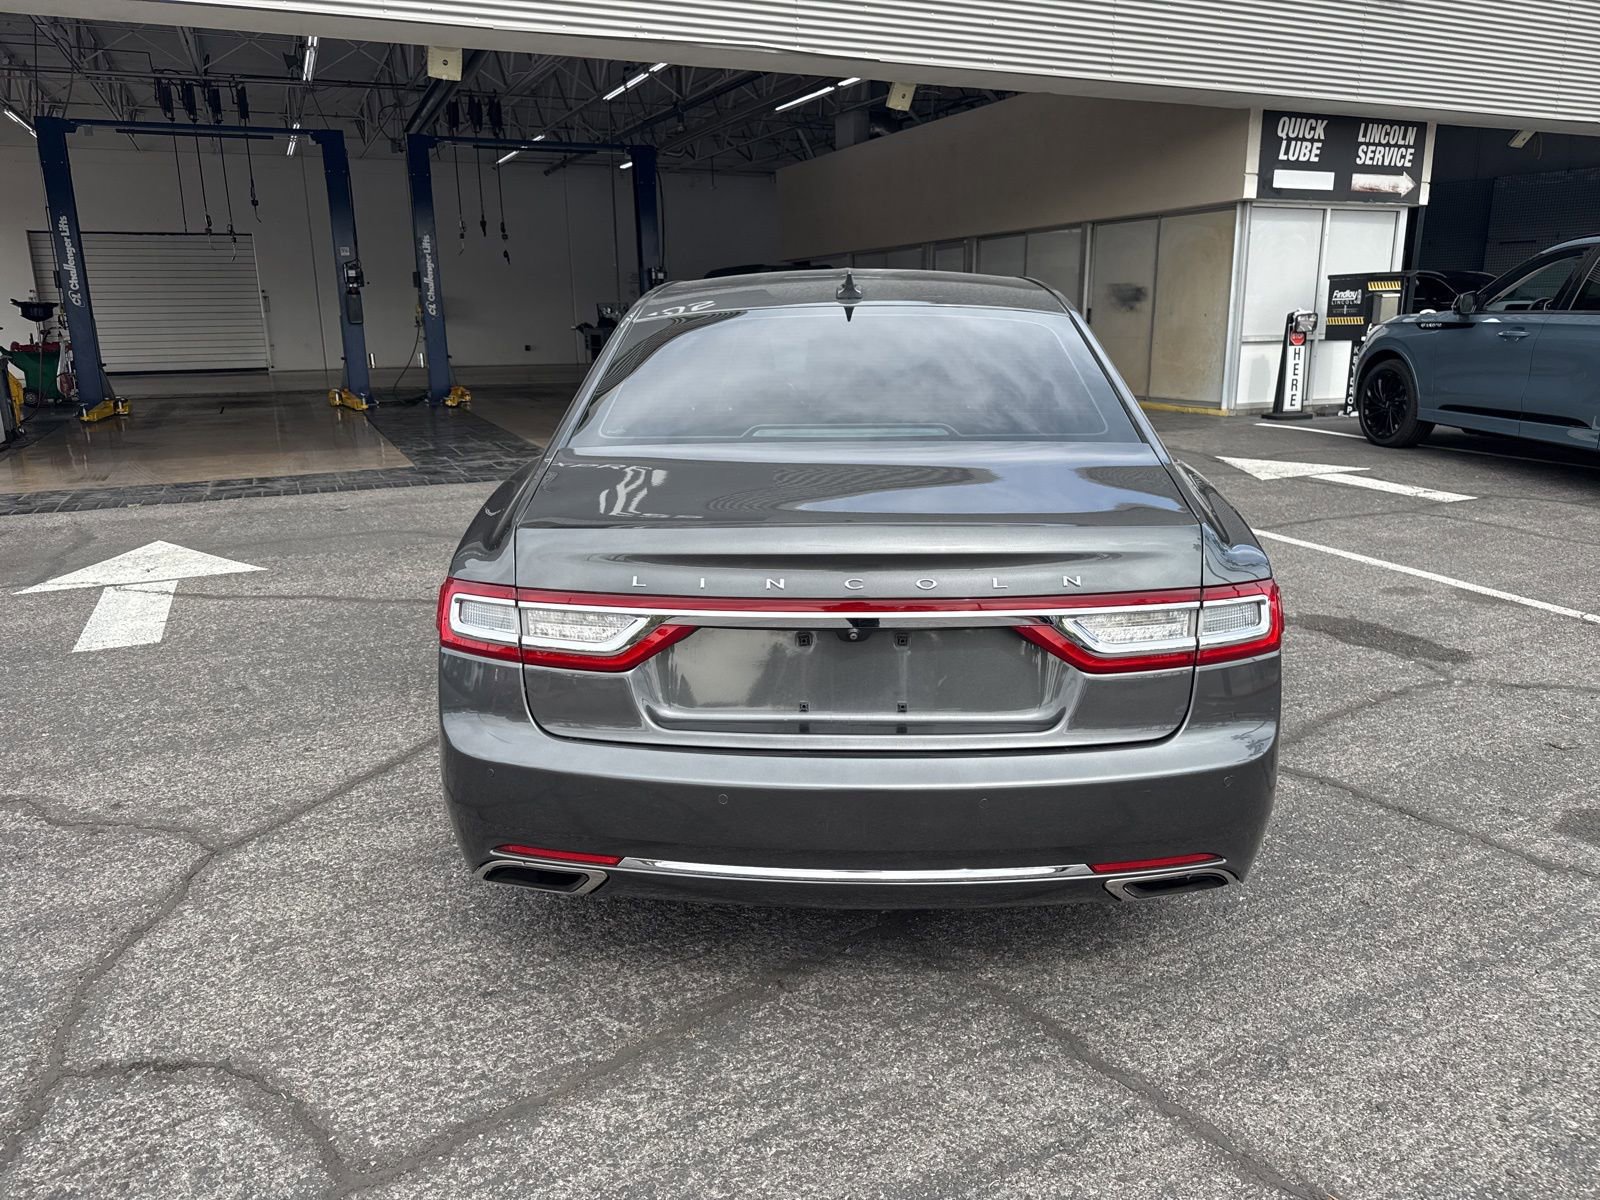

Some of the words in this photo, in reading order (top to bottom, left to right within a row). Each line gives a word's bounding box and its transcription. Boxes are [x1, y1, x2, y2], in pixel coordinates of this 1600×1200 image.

[1277, 116, 1328, 140] QUICK
[1357, 123, 1417, 146] LINCOLN
[1278, 140, 1322, 162] LUBE
[1356, 145, 1415, 167] SERVICE
[58, 215, 70, 236] Lifts
[422, 234, 431, 253] Lifts
[63, 237, 79, 290] Challenger
[424, 254, 435, 301] Challenger
[1332, 289, 1357, 300] Findlay
[1289, 347, 1301, 407] HERE
[631, 575, 1081, 590] LINCOLN
